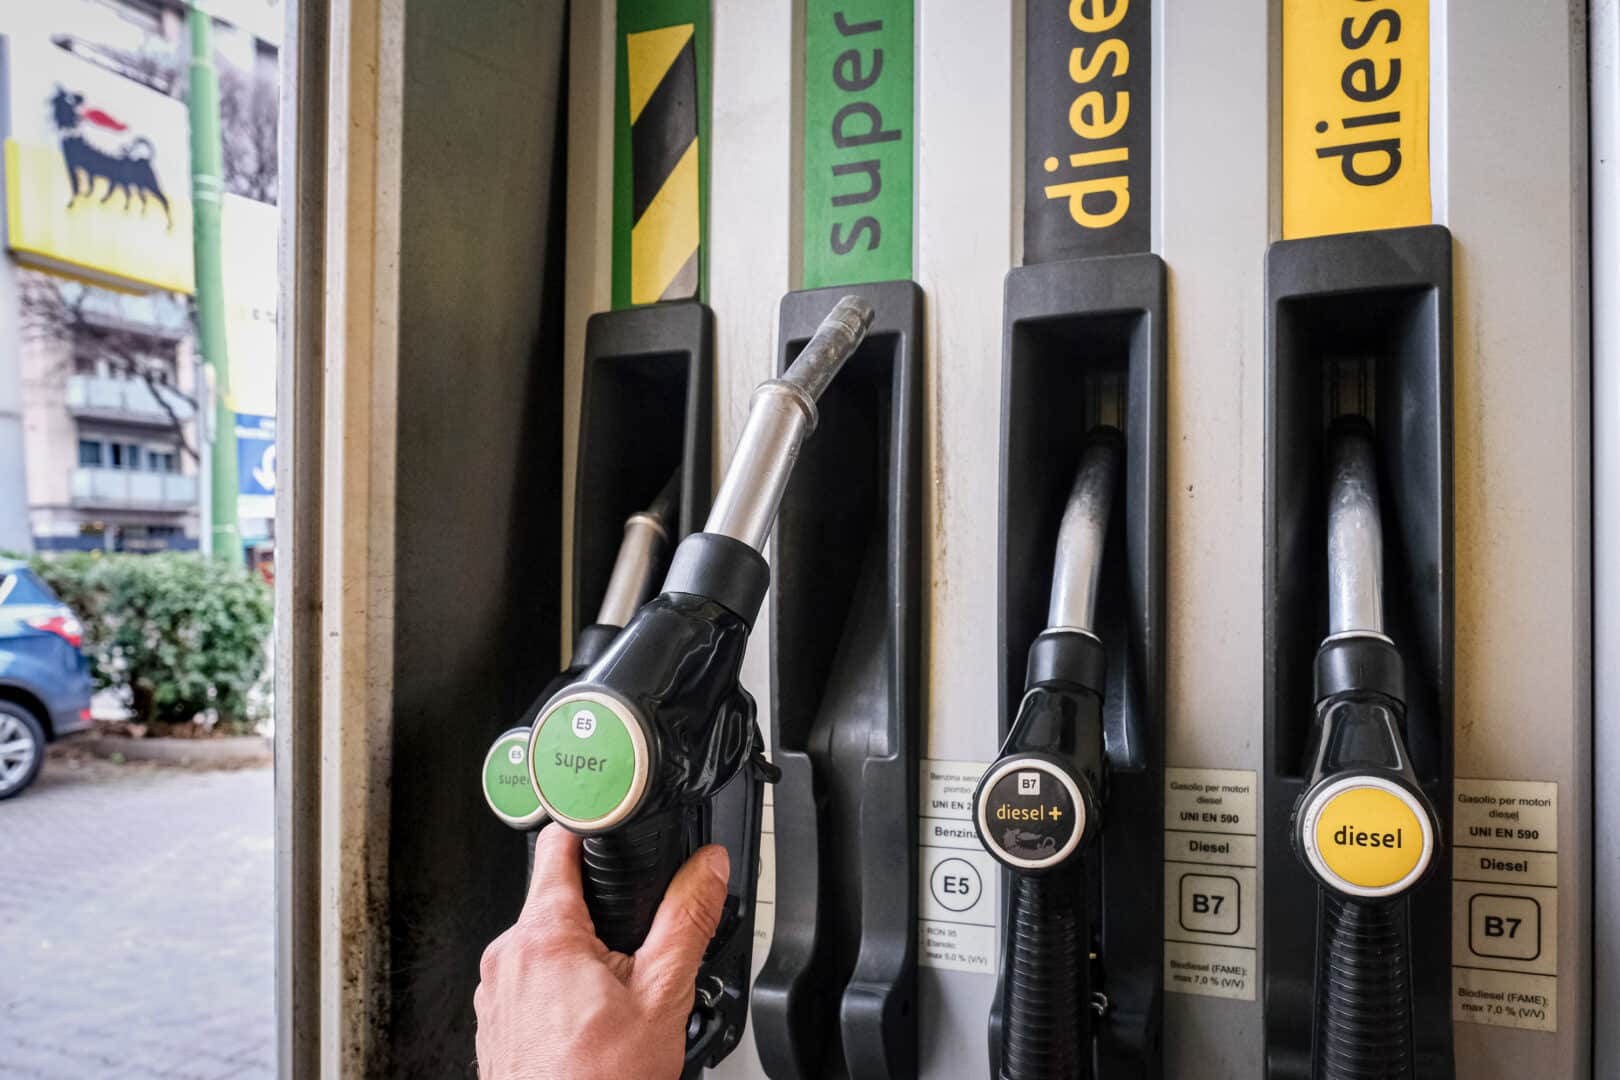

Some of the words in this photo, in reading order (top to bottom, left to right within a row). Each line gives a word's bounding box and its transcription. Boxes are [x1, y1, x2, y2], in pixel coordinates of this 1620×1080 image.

[1316, 0, 1402, 187] dies
[830, 11, 902, 256] super
[576, 717, 592, 731] E5
[555, 752, 608, 773] super
[1022, 779, 1037, 789] B7
[1170, 781, 1204, 792] Gasolio
[1205, 784, 1220, 793] per
[1221, 785, 1250, 793] motori
[932, 800, 949, 809] UNI
[951, 802, 964, 810] EN
[1196, 796, 1222, 805] diesel
[1458, 793, 1496, 805] Gasolio
[1499, 797, 1516, 806] per
[1519, 798, 1551, 807] motori
[996, 803, 1044, 821] diesel
[1180, 812, 1199, 822] UNI
[1202, 813, 1217, 823] EN
[1220, 814, 1239, 824] 590
[1489, 810, 1519, 820] diesel
[1334, 825, 1402, 849] diesel
[1470, 826, 1491, 837] UNI
[1496, 827, 1513, 838] EN
[1517, 829, 1539, 840] 590
[1189, 840, 1230, 854] Diesel
[1480, 857, 1528, 873] Diesel
[943, 875, 970, 896] E5
[1192, 894, 1225, 915] B7
[1485, 916, 1522, 938] B7
[1221, 978, 1245, 990] (V/V)
[1458, 987, 1504, 1001] Biodiesel
[1462, 1003, 1483, 1012] max
[1487, 1004, 1502, 1015] 7,0
[1505, 1005, 1516, 1016] %
[1518, 1008, 1545, 1020] (V/V)
